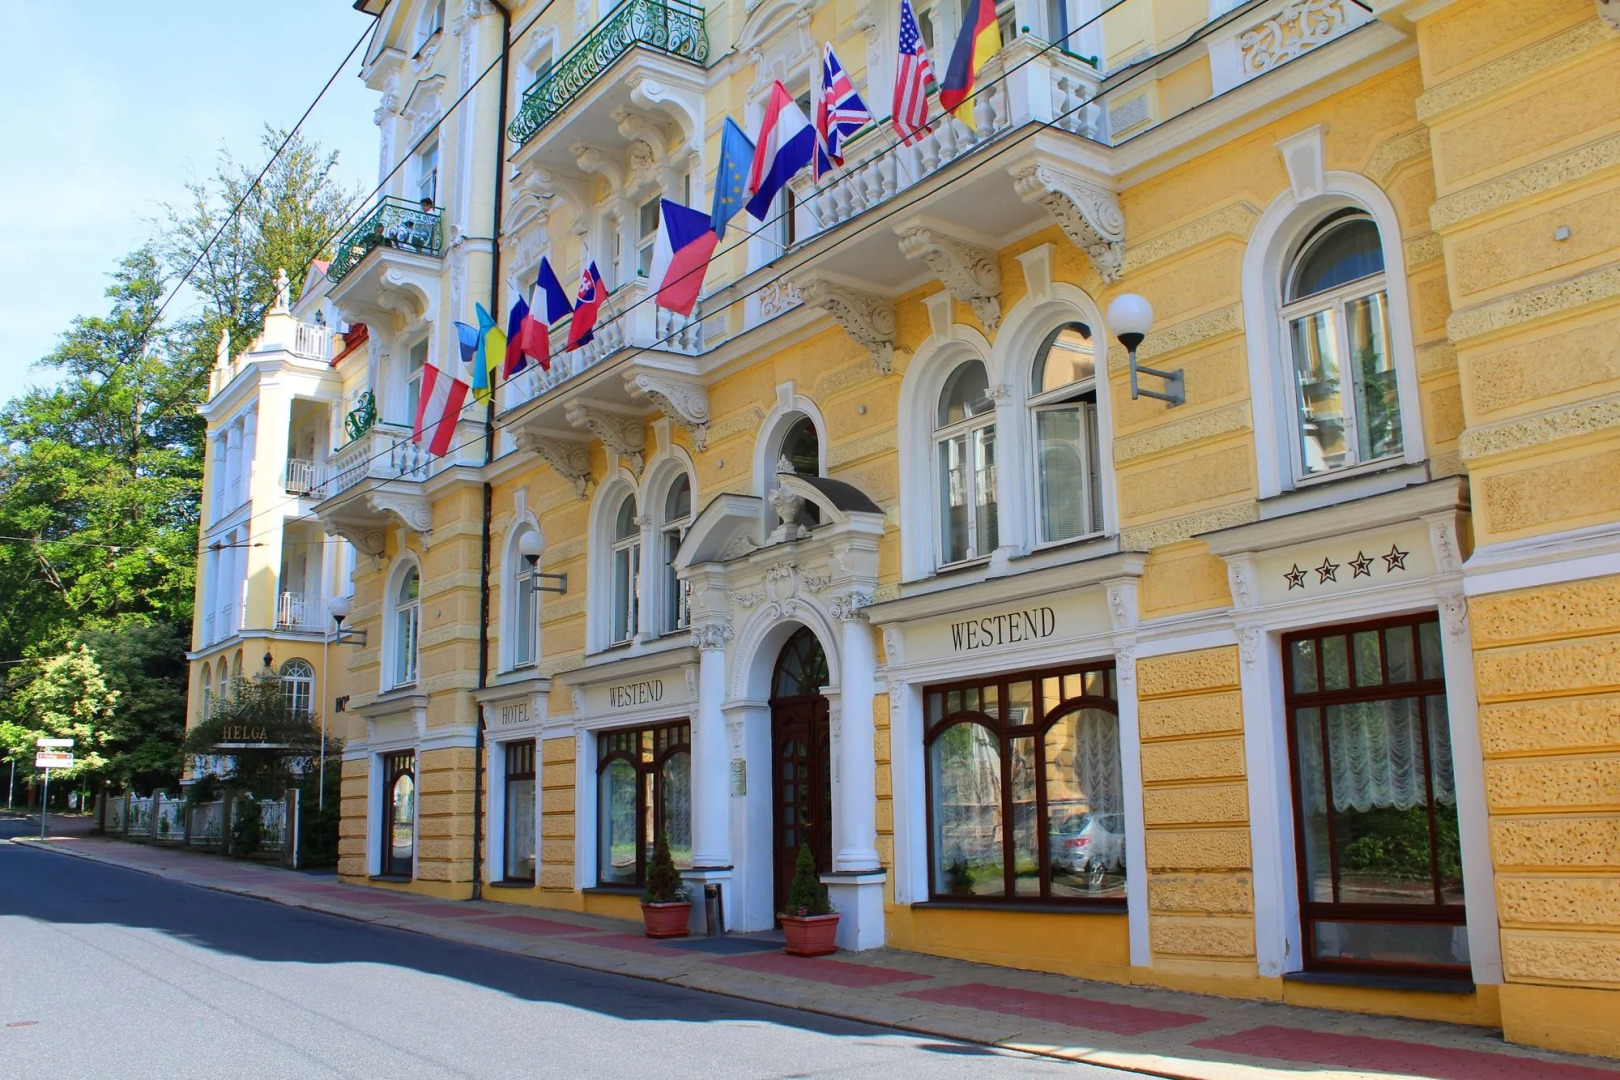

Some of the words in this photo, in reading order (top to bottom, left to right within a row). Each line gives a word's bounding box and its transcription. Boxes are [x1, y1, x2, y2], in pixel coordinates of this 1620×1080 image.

[951, 607, 1055, 651] WESTEND
[609, 679, 663, 708] WESTEND
[502, 703, 529, 725] HOTEL
[222, 725, 267, 740] HELGA
